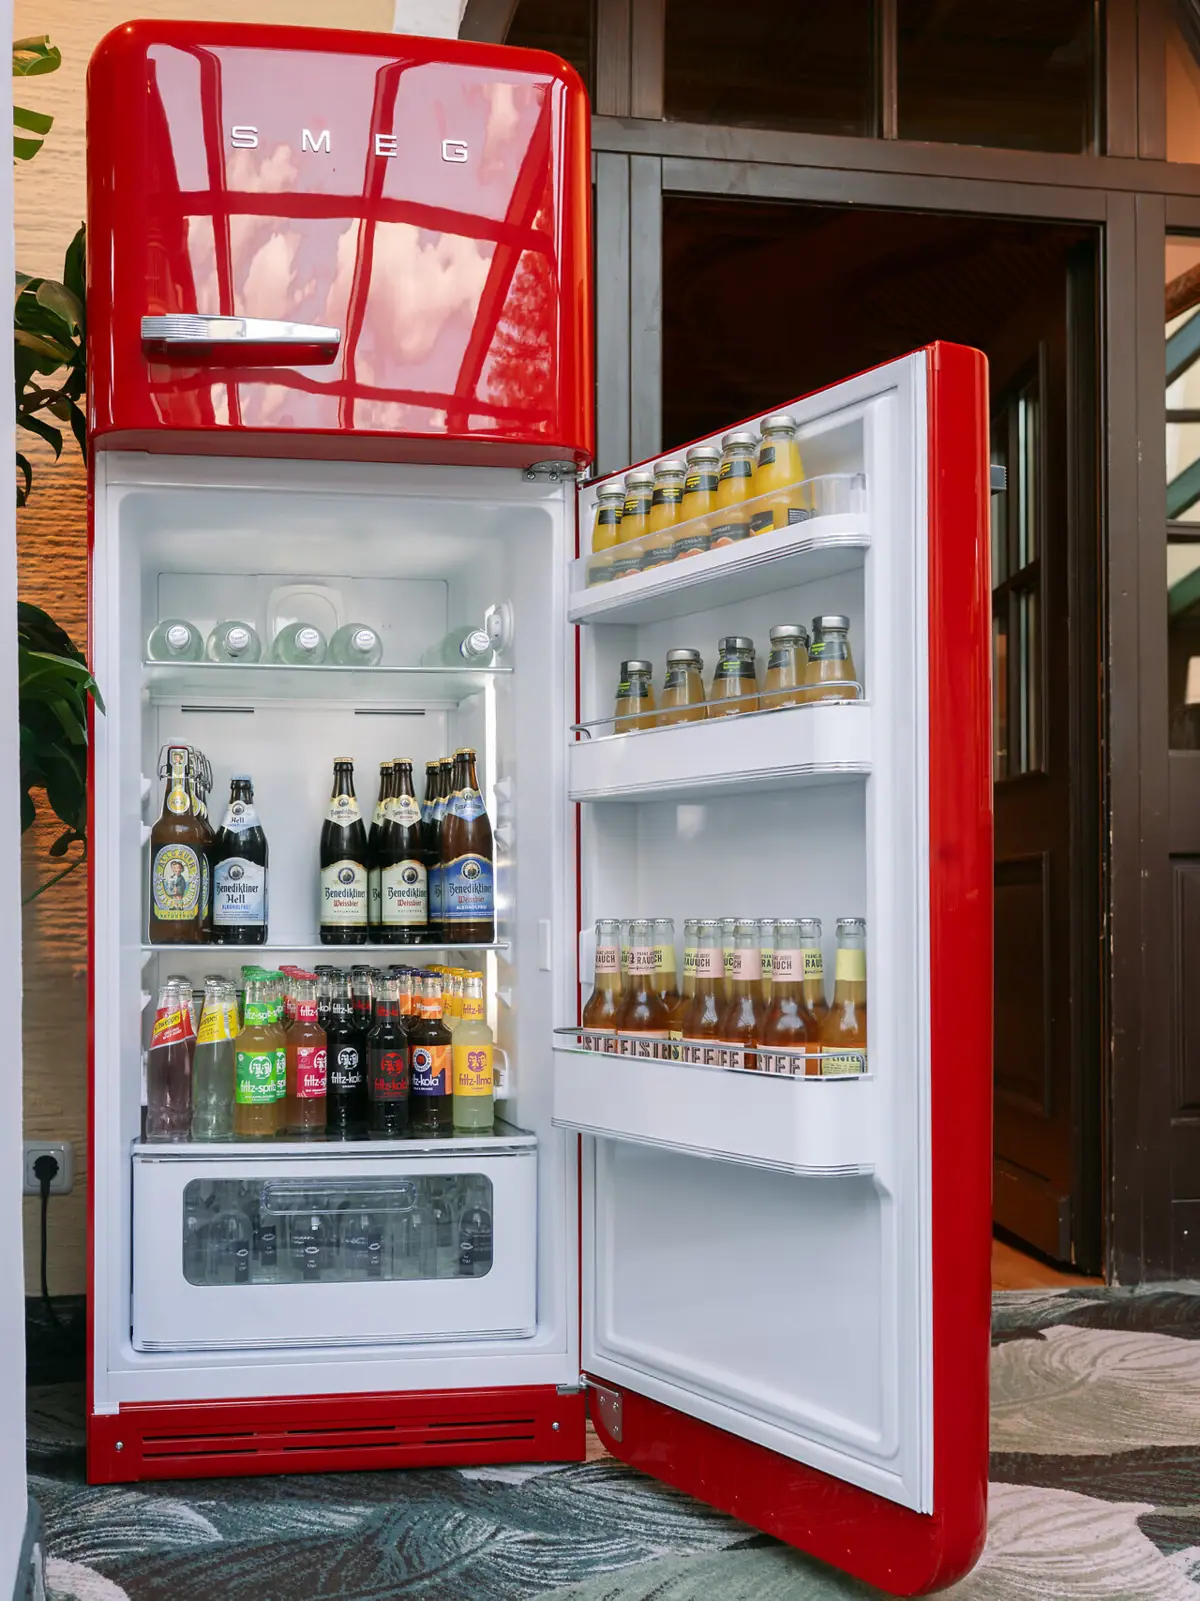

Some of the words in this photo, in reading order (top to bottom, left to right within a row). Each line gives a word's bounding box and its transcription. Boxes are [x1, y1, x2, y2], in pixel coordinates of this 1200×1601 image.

[231, 125, 469, 163] SMEG
[216, 882, 259, 894] Benediktiner
[324, 887, 366, 900] Benediktiner
[449, 883, 492, 896] Benediktiner
[226, 894, 245, 904] Hell
